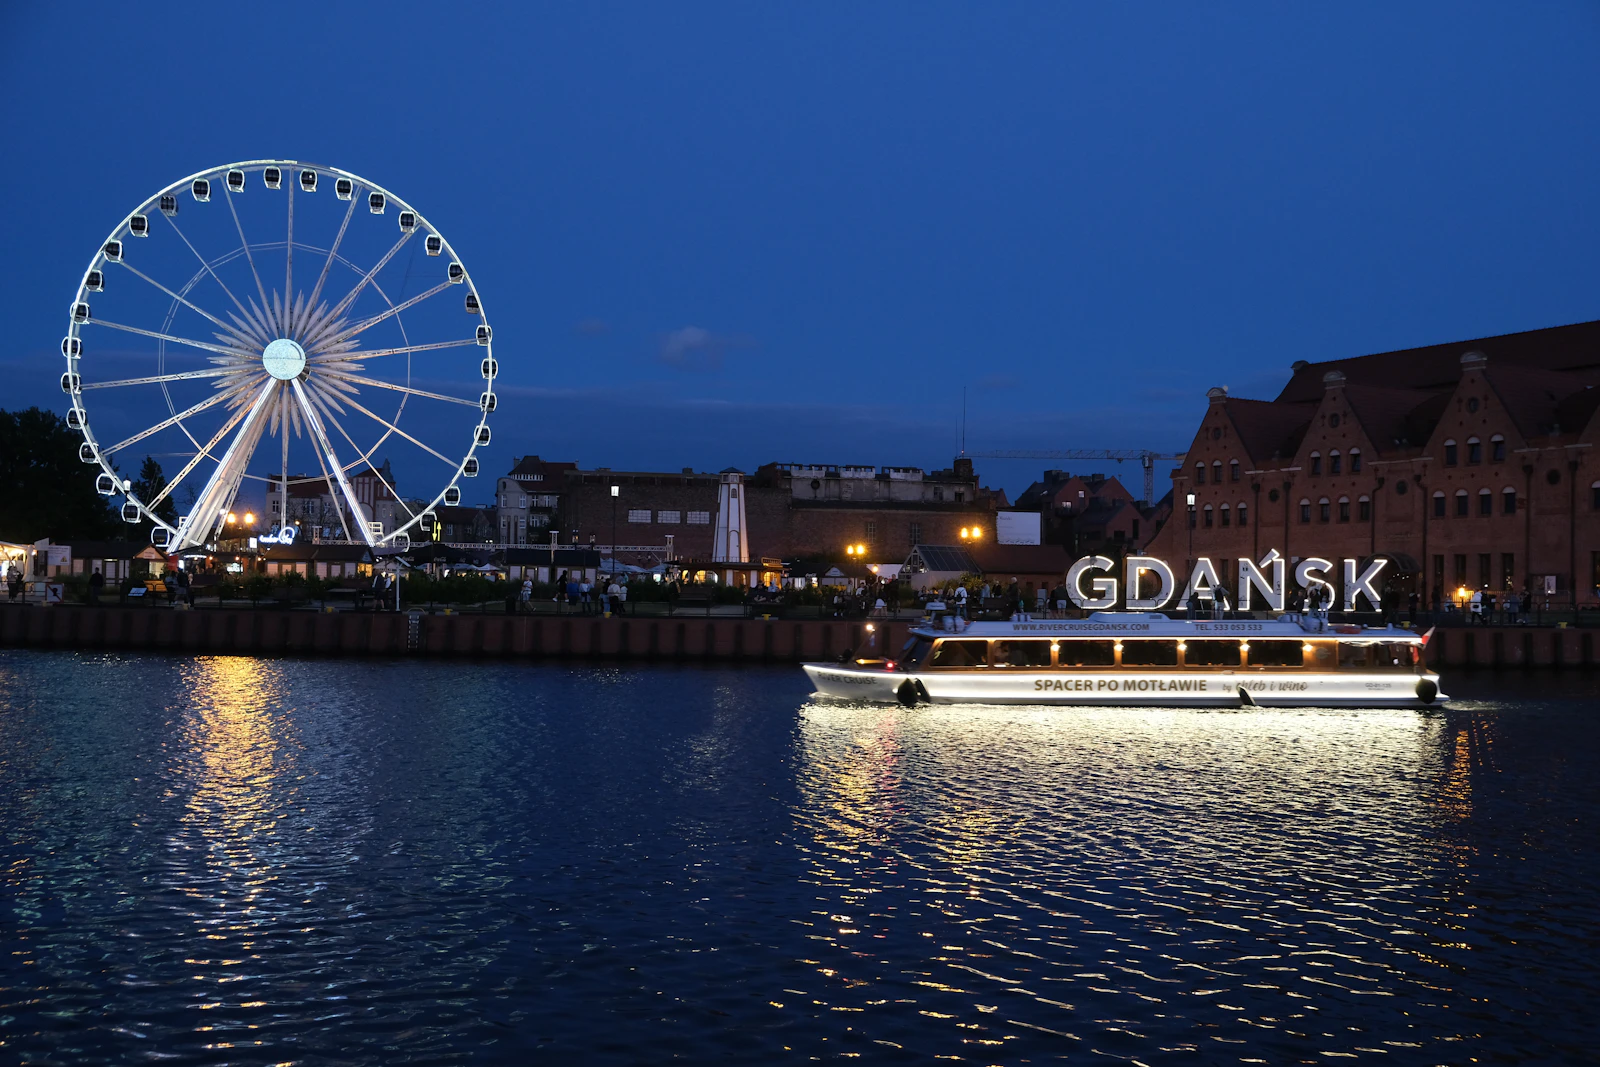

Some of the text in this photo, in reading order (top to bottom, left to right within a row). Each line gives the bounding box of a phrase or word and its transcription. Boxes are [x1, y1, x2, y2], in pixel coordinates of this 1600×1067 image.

[1065, 548, 1388, 612] GDAŃSK
[1013, 623, 1150, 631] WWW.RIVERCRUISEGDANSK.COM
[843, 676, 878, 685] CRUISE
[1034, 679, 1207, 691] SPACER PO MOTŁAWIE
[1222, 683, 1232, 693] by
[1270, 681, 1276, 691] i
[1279, 681, 1308, 691] wino
